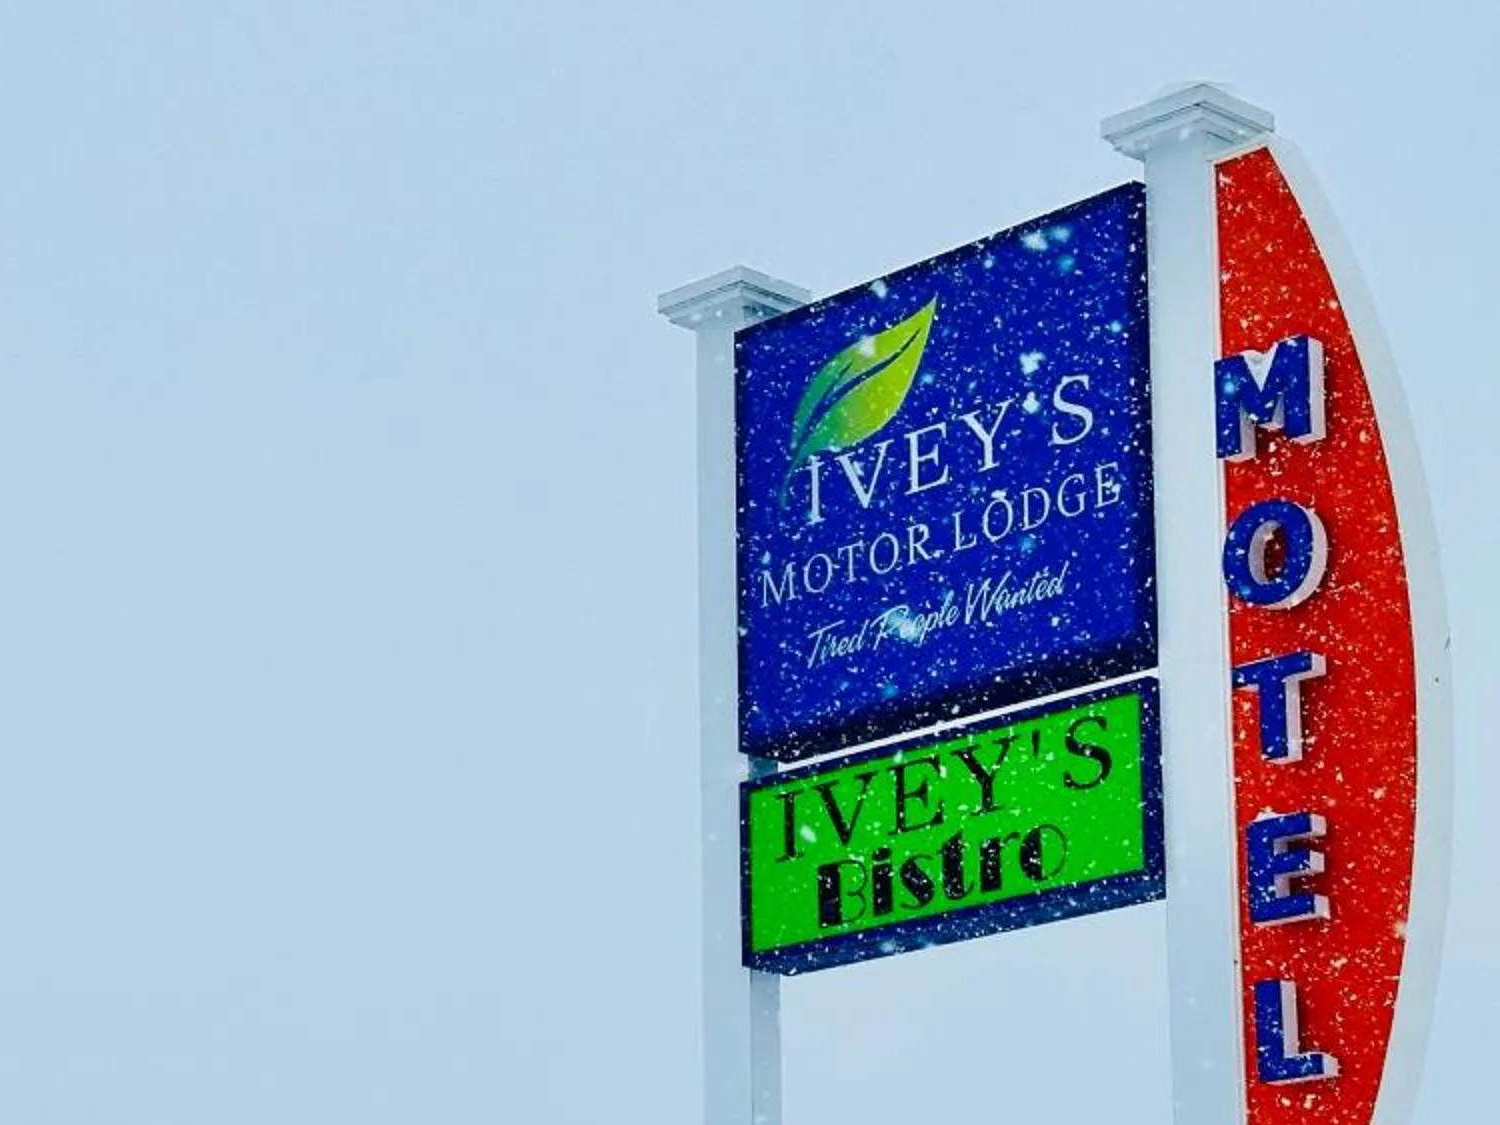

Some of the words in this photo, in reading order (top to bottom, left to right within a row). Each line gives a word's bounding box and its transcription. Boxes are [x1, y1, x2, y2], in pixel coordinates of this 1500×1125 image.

[803, 374, 1095, 526] IVEY'S
[758, 521, 937, 607] MOTOR
[952, 462, 1121, 552] LODGE
[807, 618, 870, 669] Tired
[869, 589, 961, 651] Pople
[964, 561, 1070, 624] Wanted
[1214, 335, 1338, 1085] MOTEL
[774, 715, 1113, 863] IVEY'S
[817, 823, 1069, 929] Bistro
